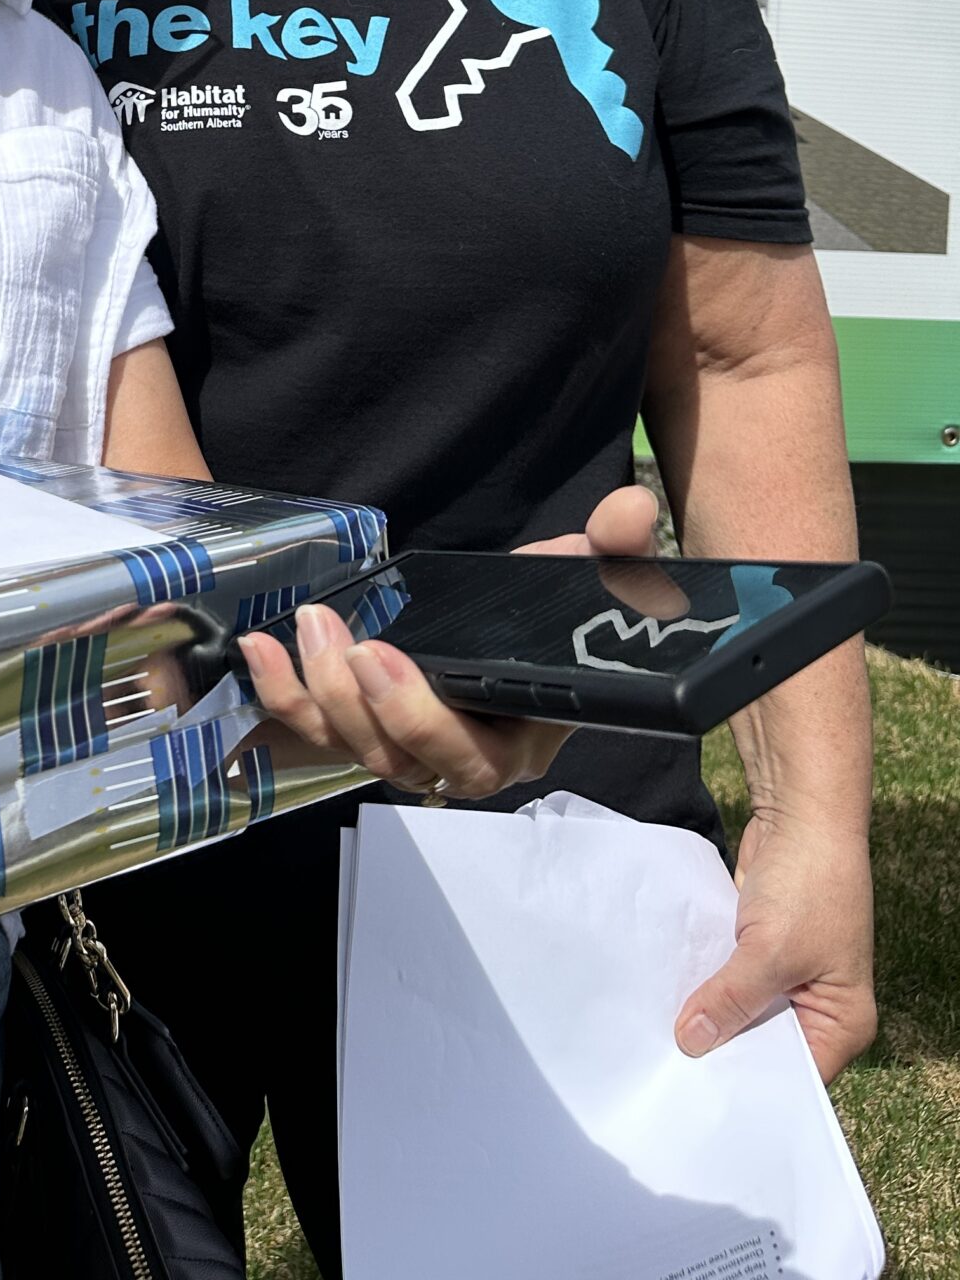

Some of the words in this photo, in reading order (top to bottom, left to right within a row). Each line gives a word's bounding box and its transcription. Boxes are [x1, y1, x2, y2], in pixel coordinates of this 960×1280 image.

[71, 0, 212, 70] the
[160, 84, 246, 108] Habitat
[160, 107, 180, 120] for
[276, 80, 353, 136] 35
[160, 119, 204, 132] Southern
[206, 117, 243, 130] Alberta
[318, 128, 350, 141] years
[728, 1235, 761, 1254] Photos
